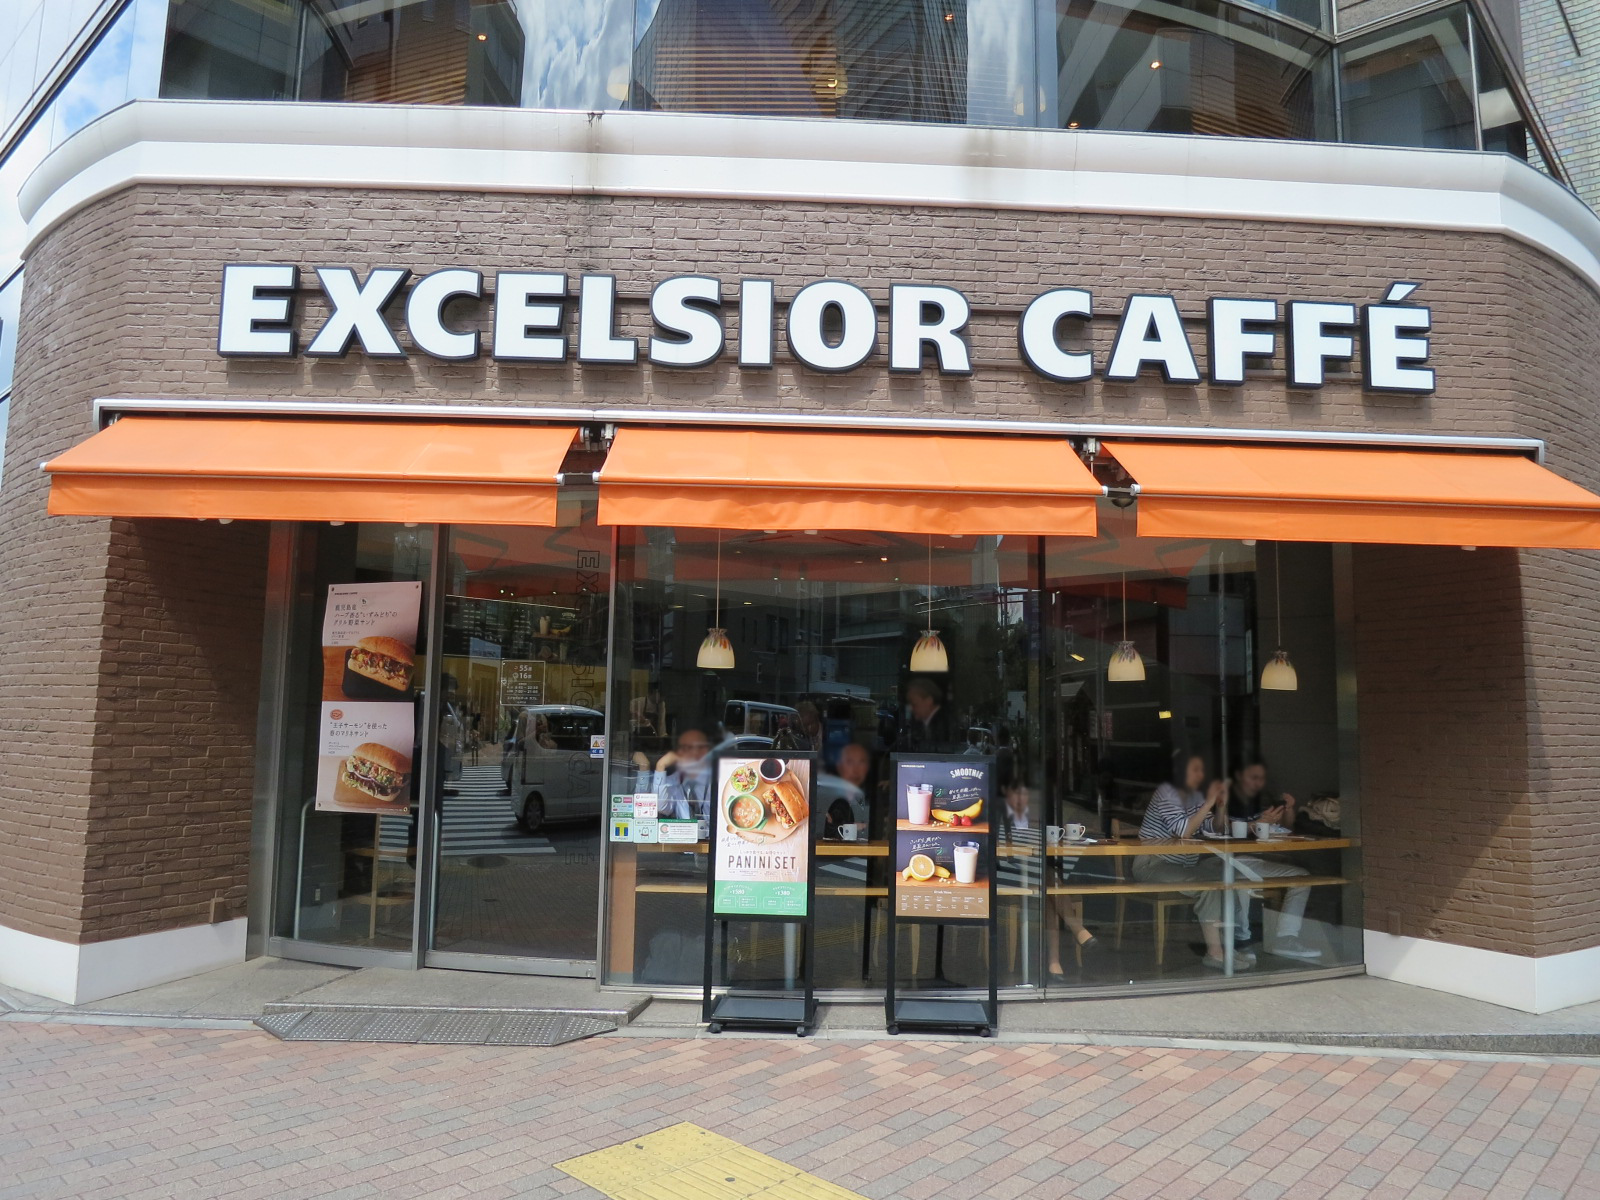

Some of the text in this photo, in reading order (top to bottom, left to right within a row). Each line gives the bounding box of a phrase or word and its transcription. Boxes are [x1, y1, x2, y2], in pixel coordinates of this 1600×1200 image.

[218, 263, 1436, 394] EXCELSIOR CAFFÉ
[568, 550, 600, 737] EXCESIO
[950, 767, 984, 779] SMOOTHIE
[728, 855, 797, 870] PANINI SET
